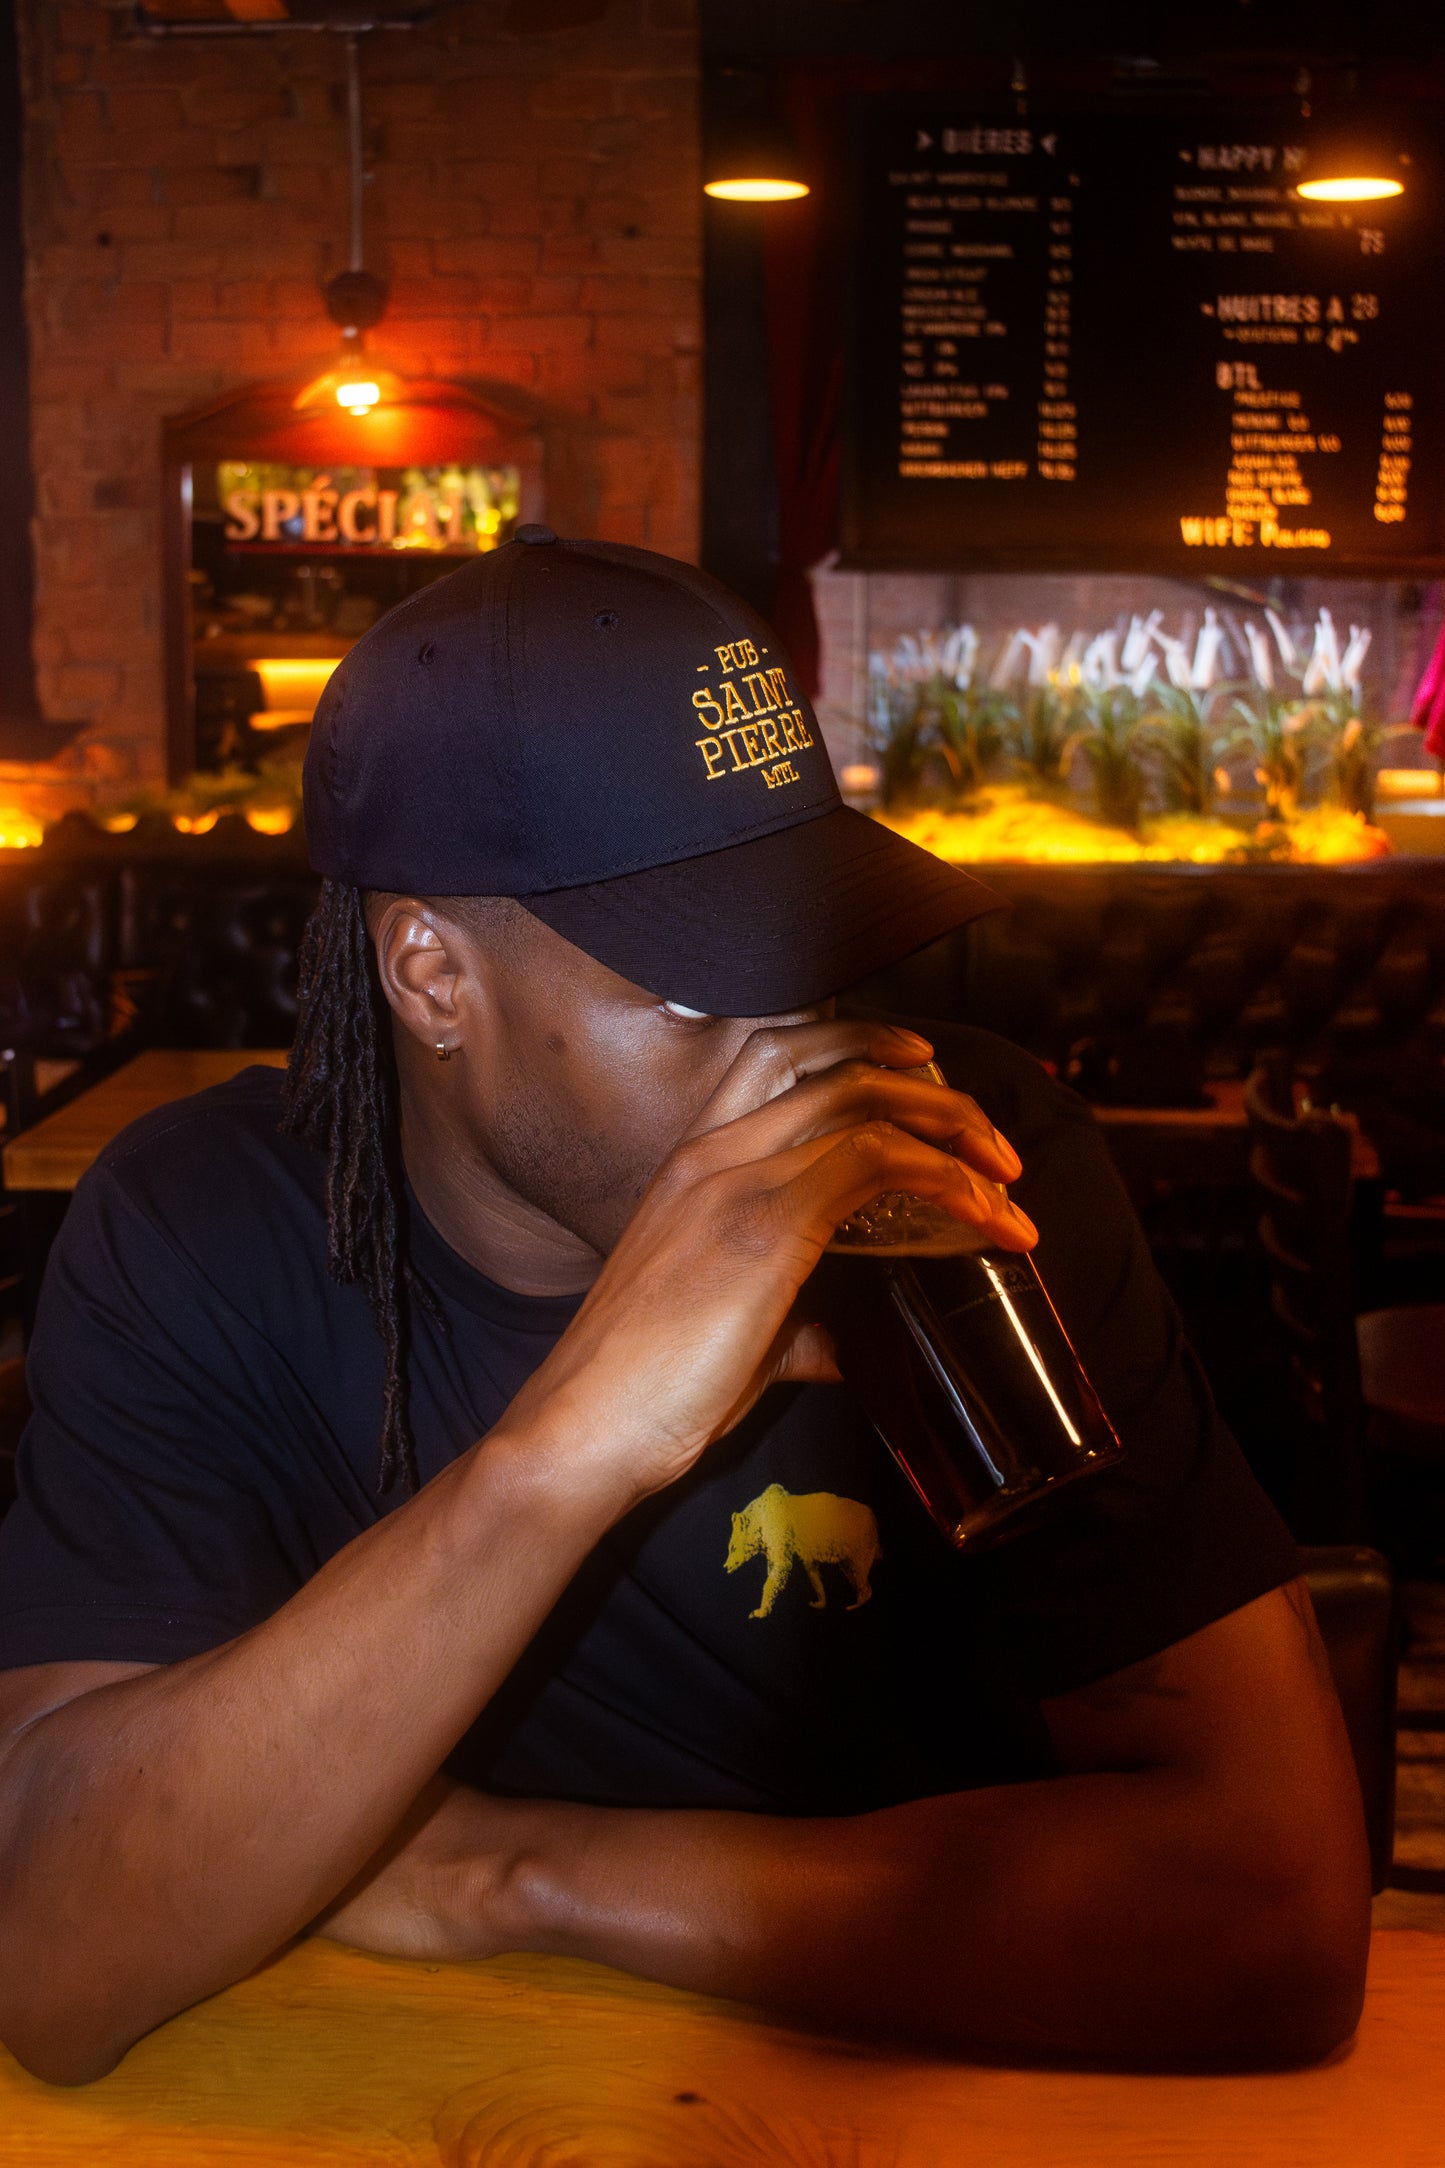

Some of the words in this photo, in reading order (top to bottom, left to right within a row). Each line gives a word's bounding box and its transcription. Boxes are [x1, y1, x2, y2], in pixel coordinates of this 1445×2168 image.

[1197, 145, 1276, 171] HAPPY
[714, 638, 760, 674] PUB
[692, 667, 794, 731] SAINT
[695, 709, 815, 781] PIERRE
[760, 760, 801, 790] MTL
